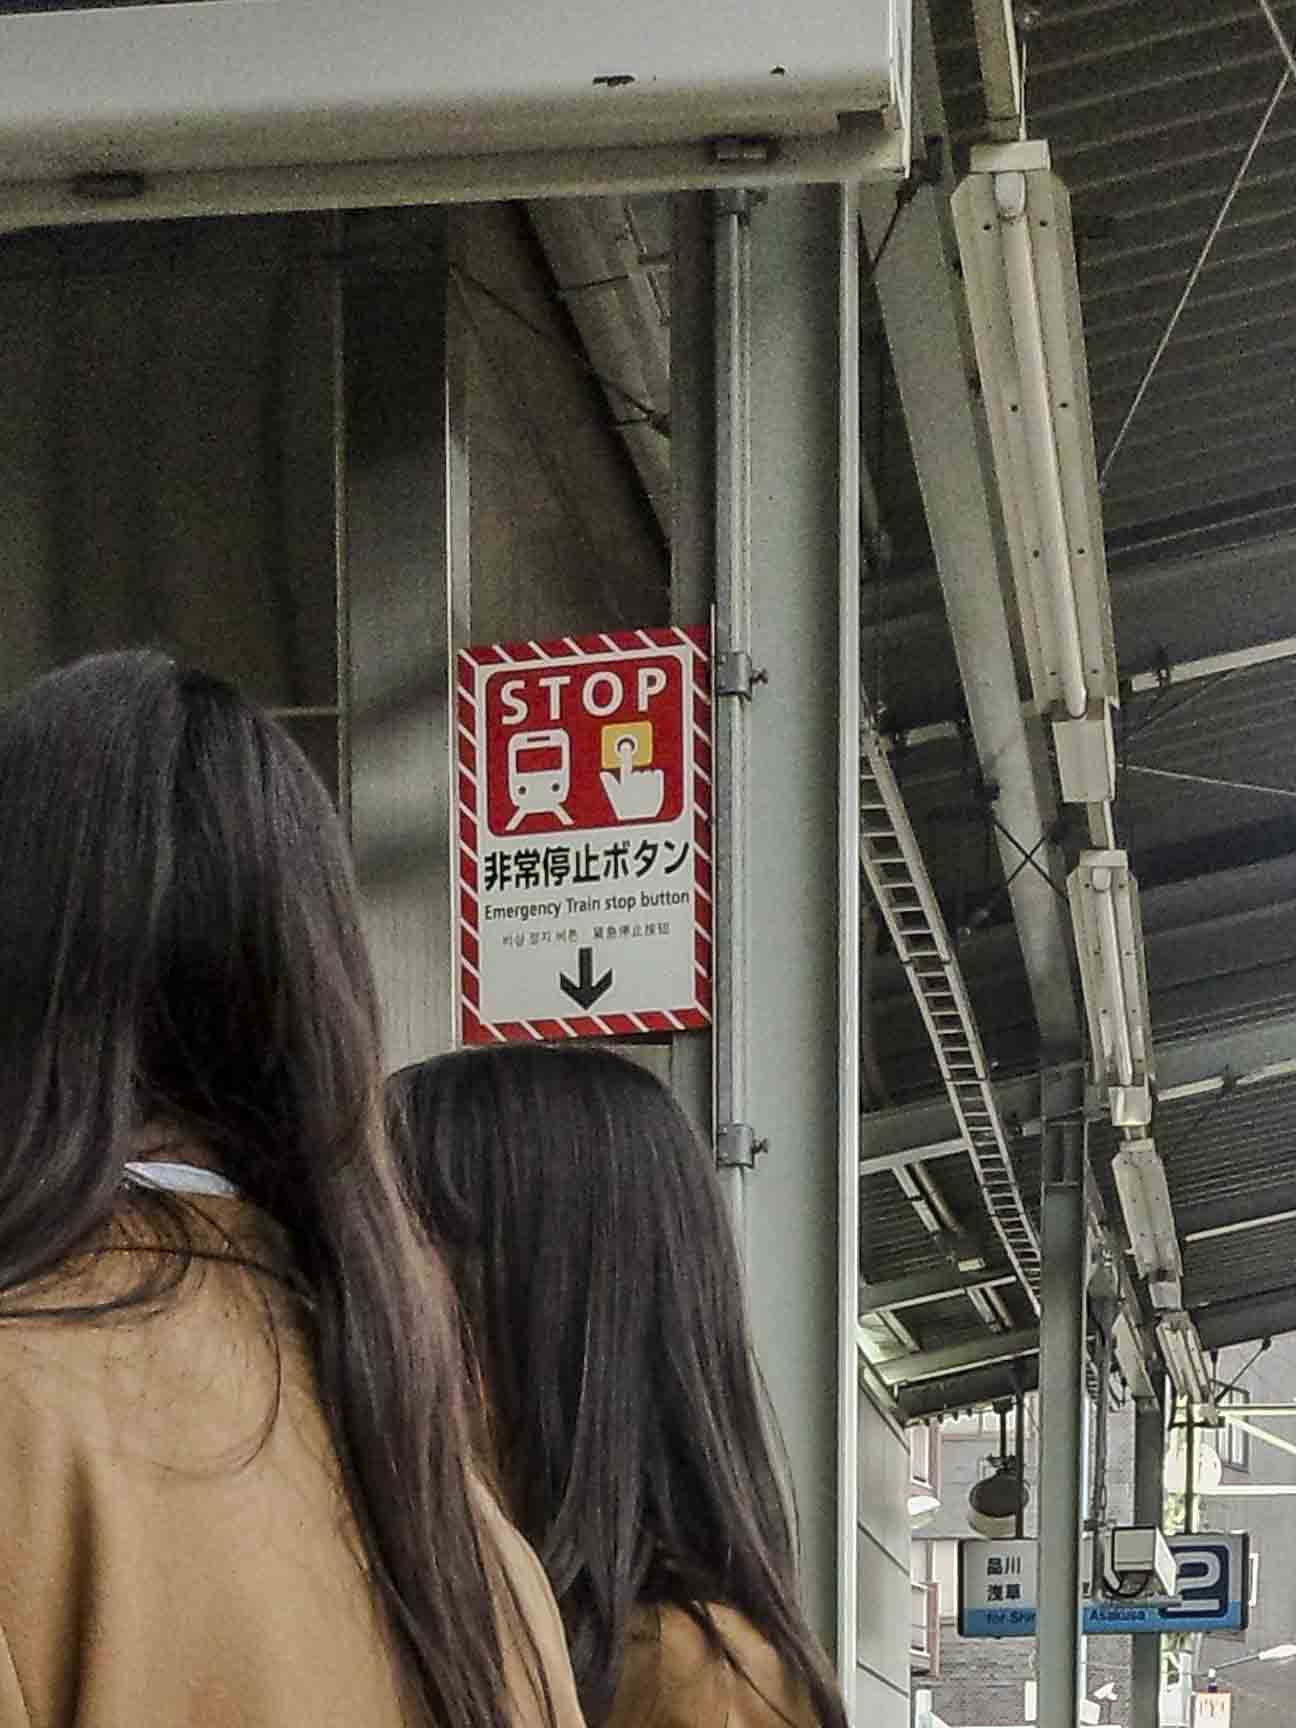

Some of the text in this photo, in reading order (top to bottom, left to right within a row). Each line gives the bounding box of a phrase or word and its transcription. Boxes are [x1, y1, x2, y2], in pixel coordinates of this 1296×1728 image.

[500, 666, 667, 726] STOP
[484, 840, 690, 893] 非常停止ボタン
[484, 889, 690, 922] Emergency Train stop button
[986, 1555, 1022, 1576] 品川
[1167, 1551, 1222, 1612] 2
